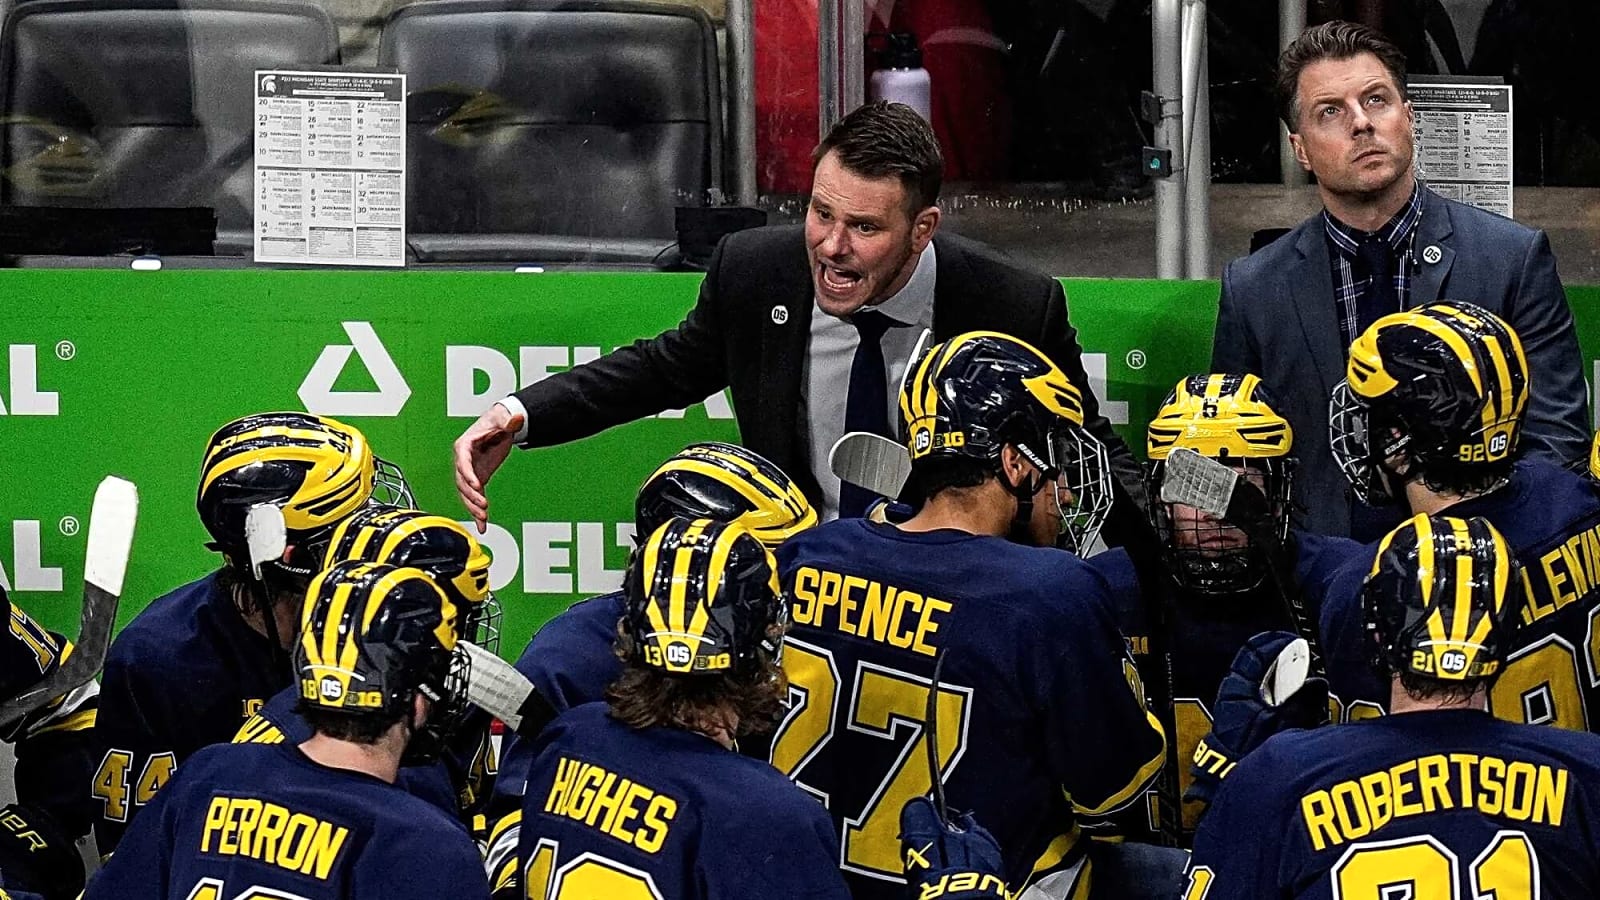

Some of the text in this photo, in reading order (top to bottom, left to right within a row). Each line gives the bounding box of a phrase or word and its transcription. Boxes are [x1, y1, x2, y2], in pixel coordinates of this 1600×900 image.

[1459, 444, 1485, 462] 92
[792, 566, 953, 657] SPENCE
[1517, 524, 1600, 626] LENTI
[645, 645, 663, 667] 13
[1292, 599, 1326, 675] LYLITE
[1412, 651, 1434, 673] 21
[302, 679, 318, 700] 18
[92, 748, 178, 823] 44
[767, 634, 974, 884] 27
[201, 796, 349, 880] PERRON
[544, 757, 678, 854] HUGHES
[1301, 754, 1568, 851] ROBERTSON
